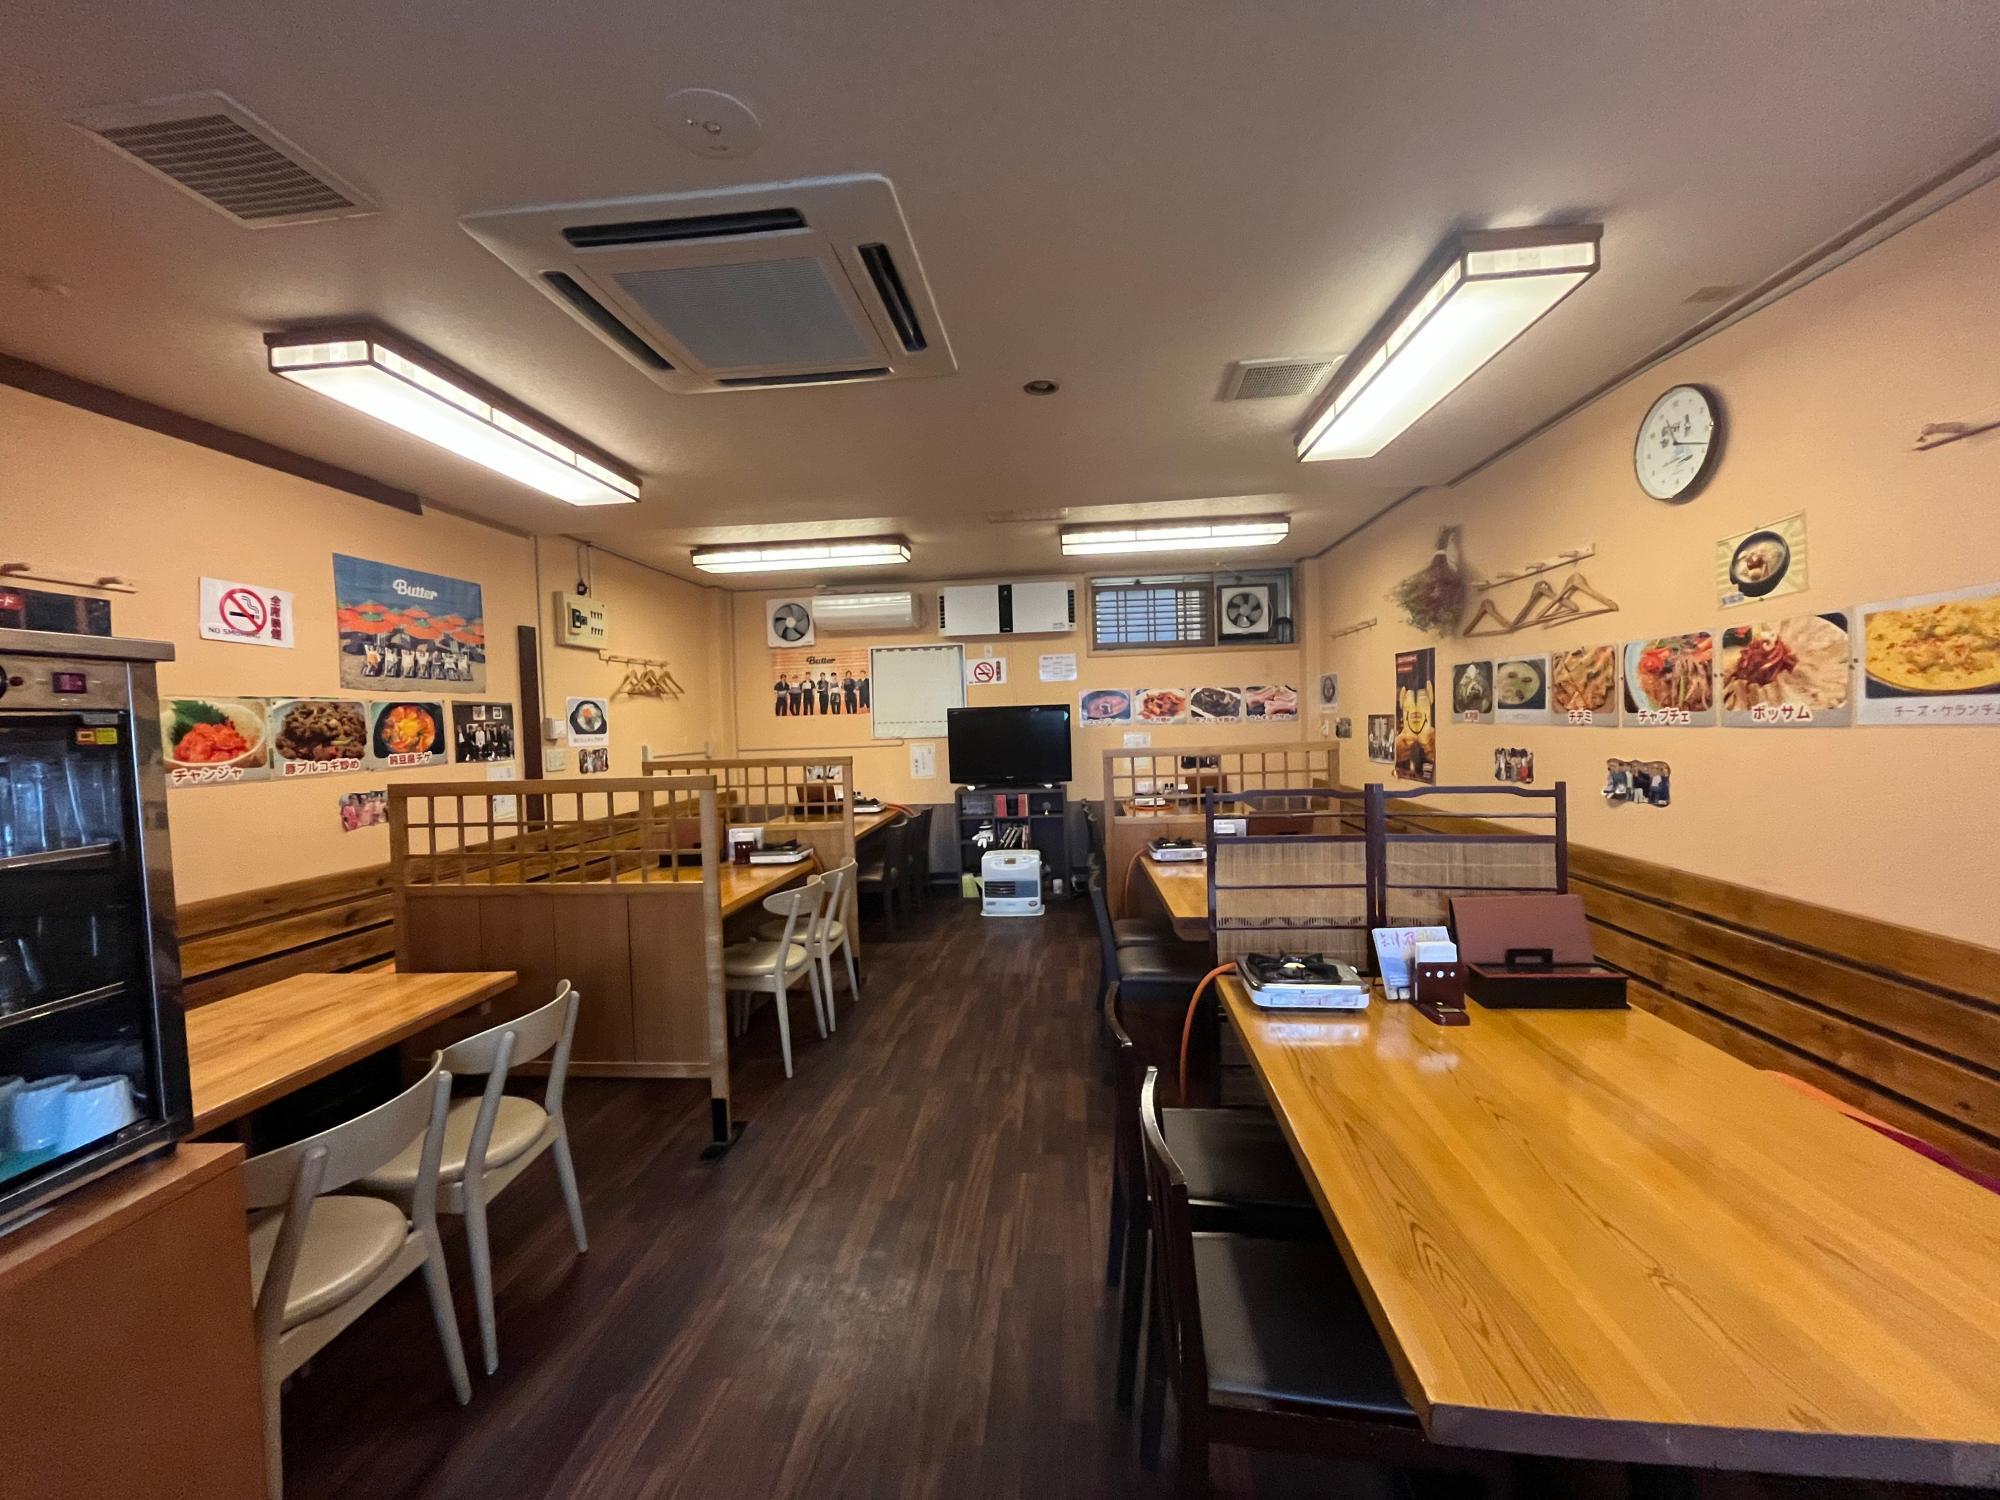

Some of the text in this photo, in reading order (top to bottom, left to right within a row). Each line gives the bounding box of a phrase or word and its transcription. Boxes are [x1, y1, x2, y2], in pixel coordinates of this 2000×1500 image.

[392, 579, 438, 600] Butter
[806, 655, 836, 664] Butter
[173, 766, 242, 784] チャンジャ
